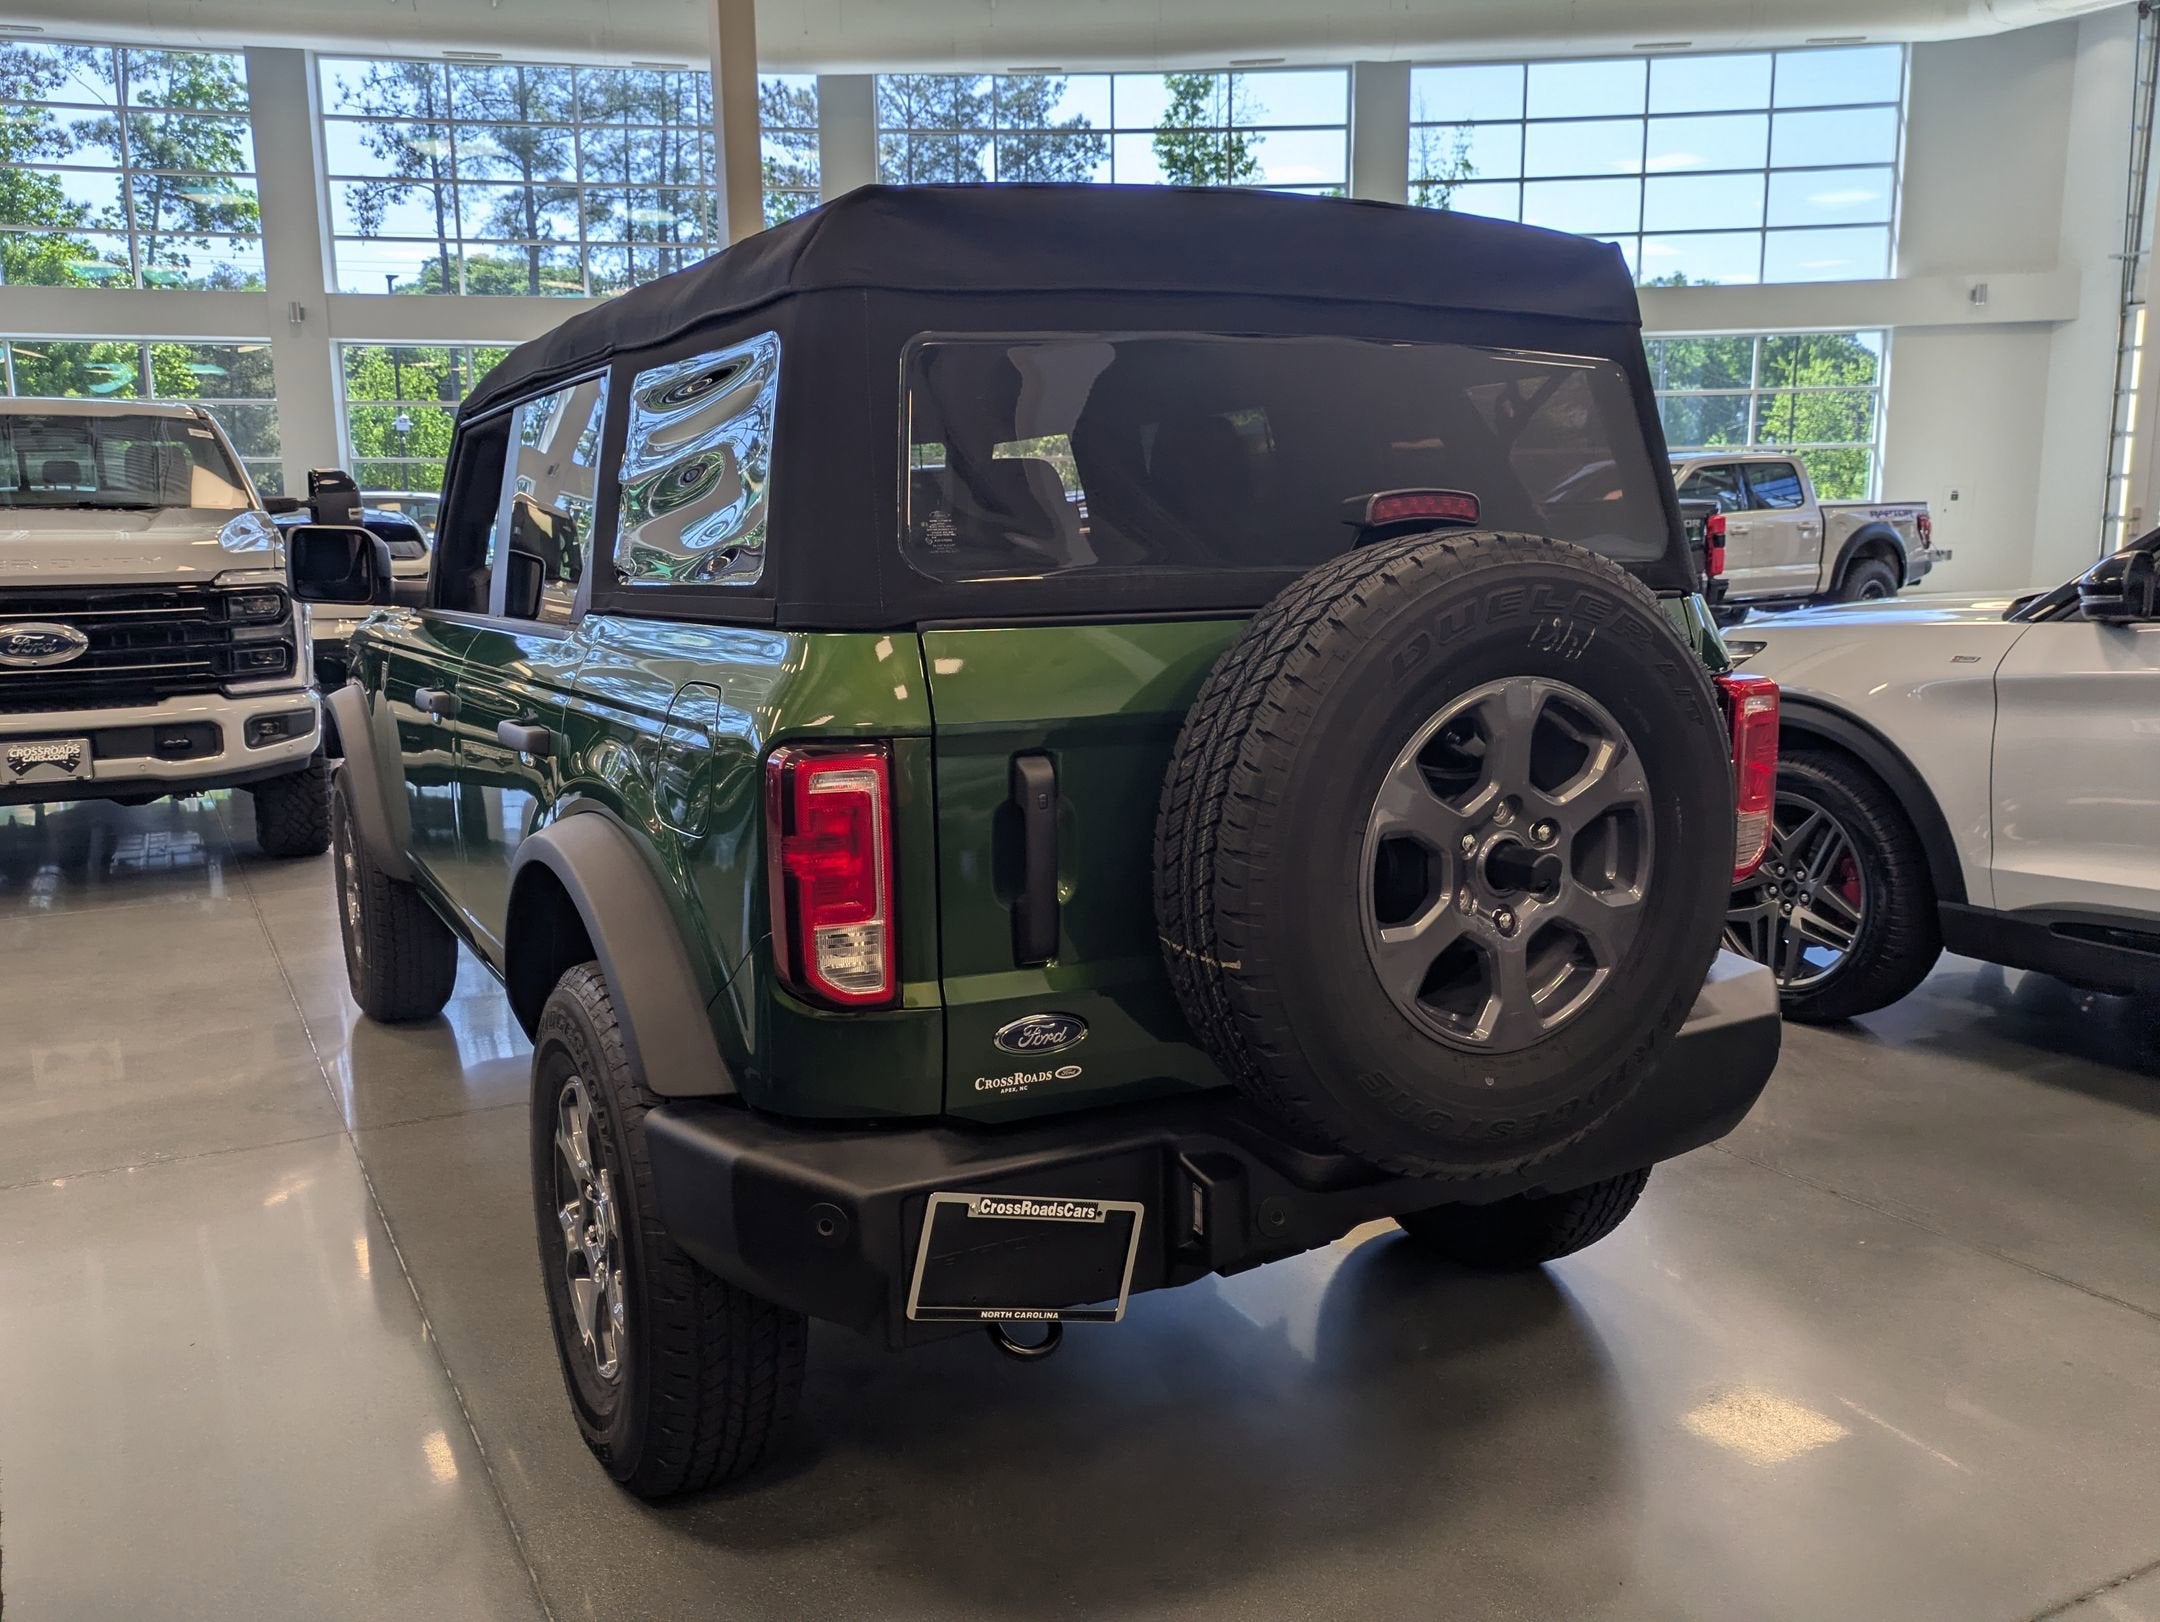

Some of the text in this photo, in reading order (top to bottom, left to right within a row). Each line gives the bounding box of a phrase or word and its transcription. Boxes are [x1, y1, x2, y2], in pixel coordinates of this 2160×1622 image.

[7, 634, 58, 655] Ford
[1388, 583, 1654, 689] DUELER
[1018, 1022, 1068, 1048] Ford
[980, 1198, 1096, 1218] CrossRoadsCars
[980, 1310, 1059, 1319] NORTH CAROLINA
